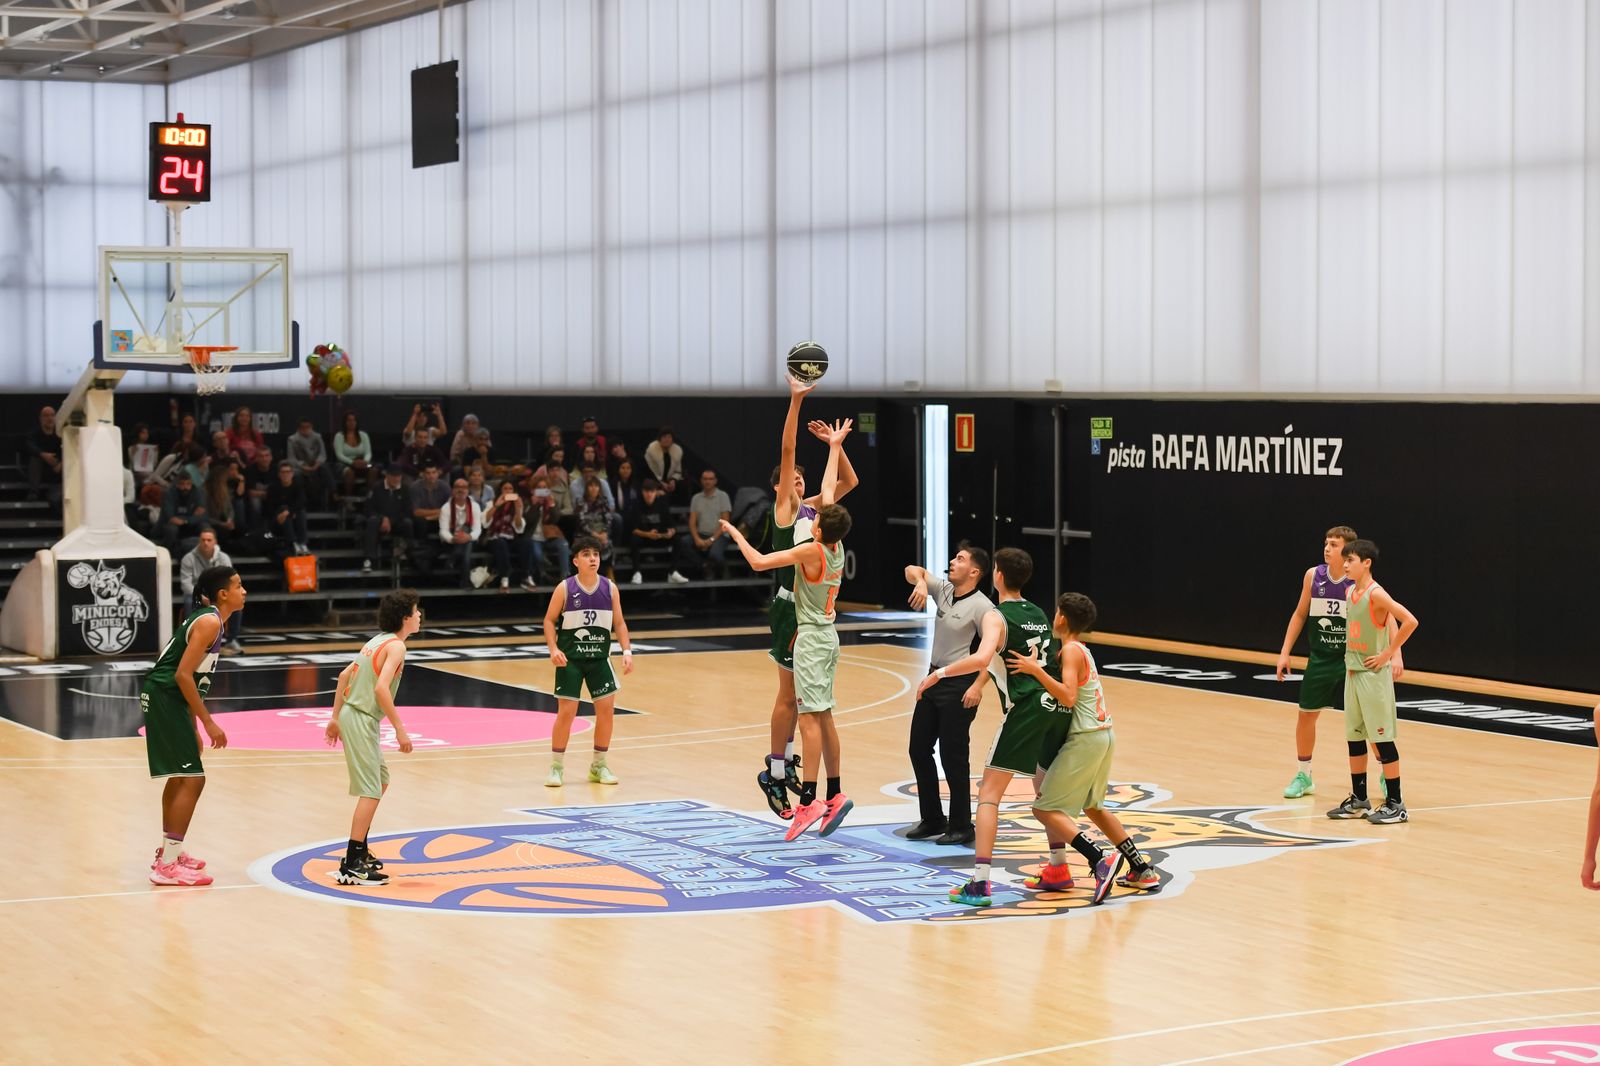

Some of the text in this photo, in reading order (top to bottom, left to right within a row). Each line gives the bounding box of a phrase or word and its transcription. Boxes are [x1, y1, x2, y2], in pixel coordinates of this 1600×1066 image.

[164, 127, 206, 146] 10:00
[160, 156, 204, 194] 24
[1107, 423, 1343, 476] pista RAFA MARTÍNEZ
[73, 605, 144, 621] MINICOPA
[1326, 600, 1340, 615] 32
[90, 618, 129, 630] ENDESA
[583, 610, 597, 626] 39
[503, 829, 801, 899] ENDESA
[537, 801, 1028, 919] MINICOPA
